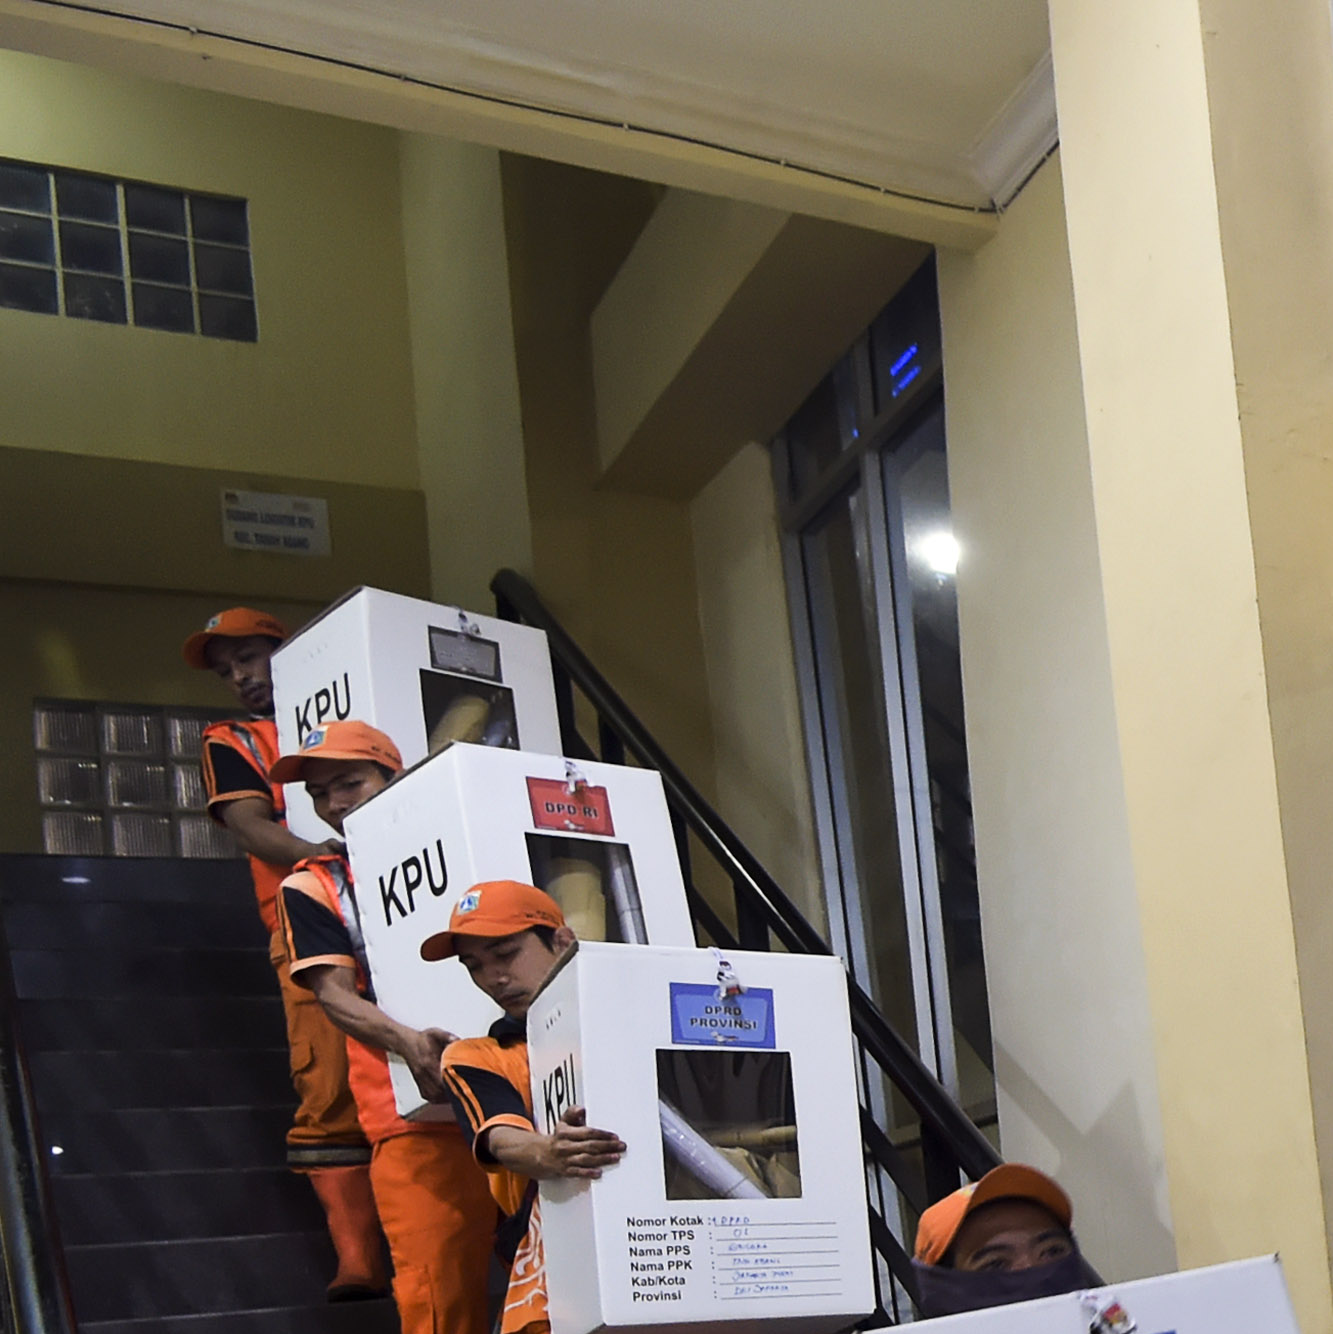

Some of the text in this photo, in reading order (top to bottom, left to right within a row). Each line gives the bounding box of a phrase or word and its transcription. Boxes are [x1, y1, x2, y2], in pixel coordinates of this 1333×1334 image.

[295, 672, 351, 746] KPU
[545, 801, 598, 819] DPD RI
[378, 838, 449, 927] KPU
[704, 1004, 743, 1017] DPRD
[690, 1017, 758, 1031] PROVINSI
[626, 1215, 704, 1228] Nomor Kotak
[628, 1230, 695, 1242] Nomor TPS
[629, 1245, 691, 1258] Nama PPS
[630, 1260, 693, 1273] Nama PPK
[631, 1275, 686, 1287] Kab/Kota
[633, 1290, 682, 1302] Provinsi
